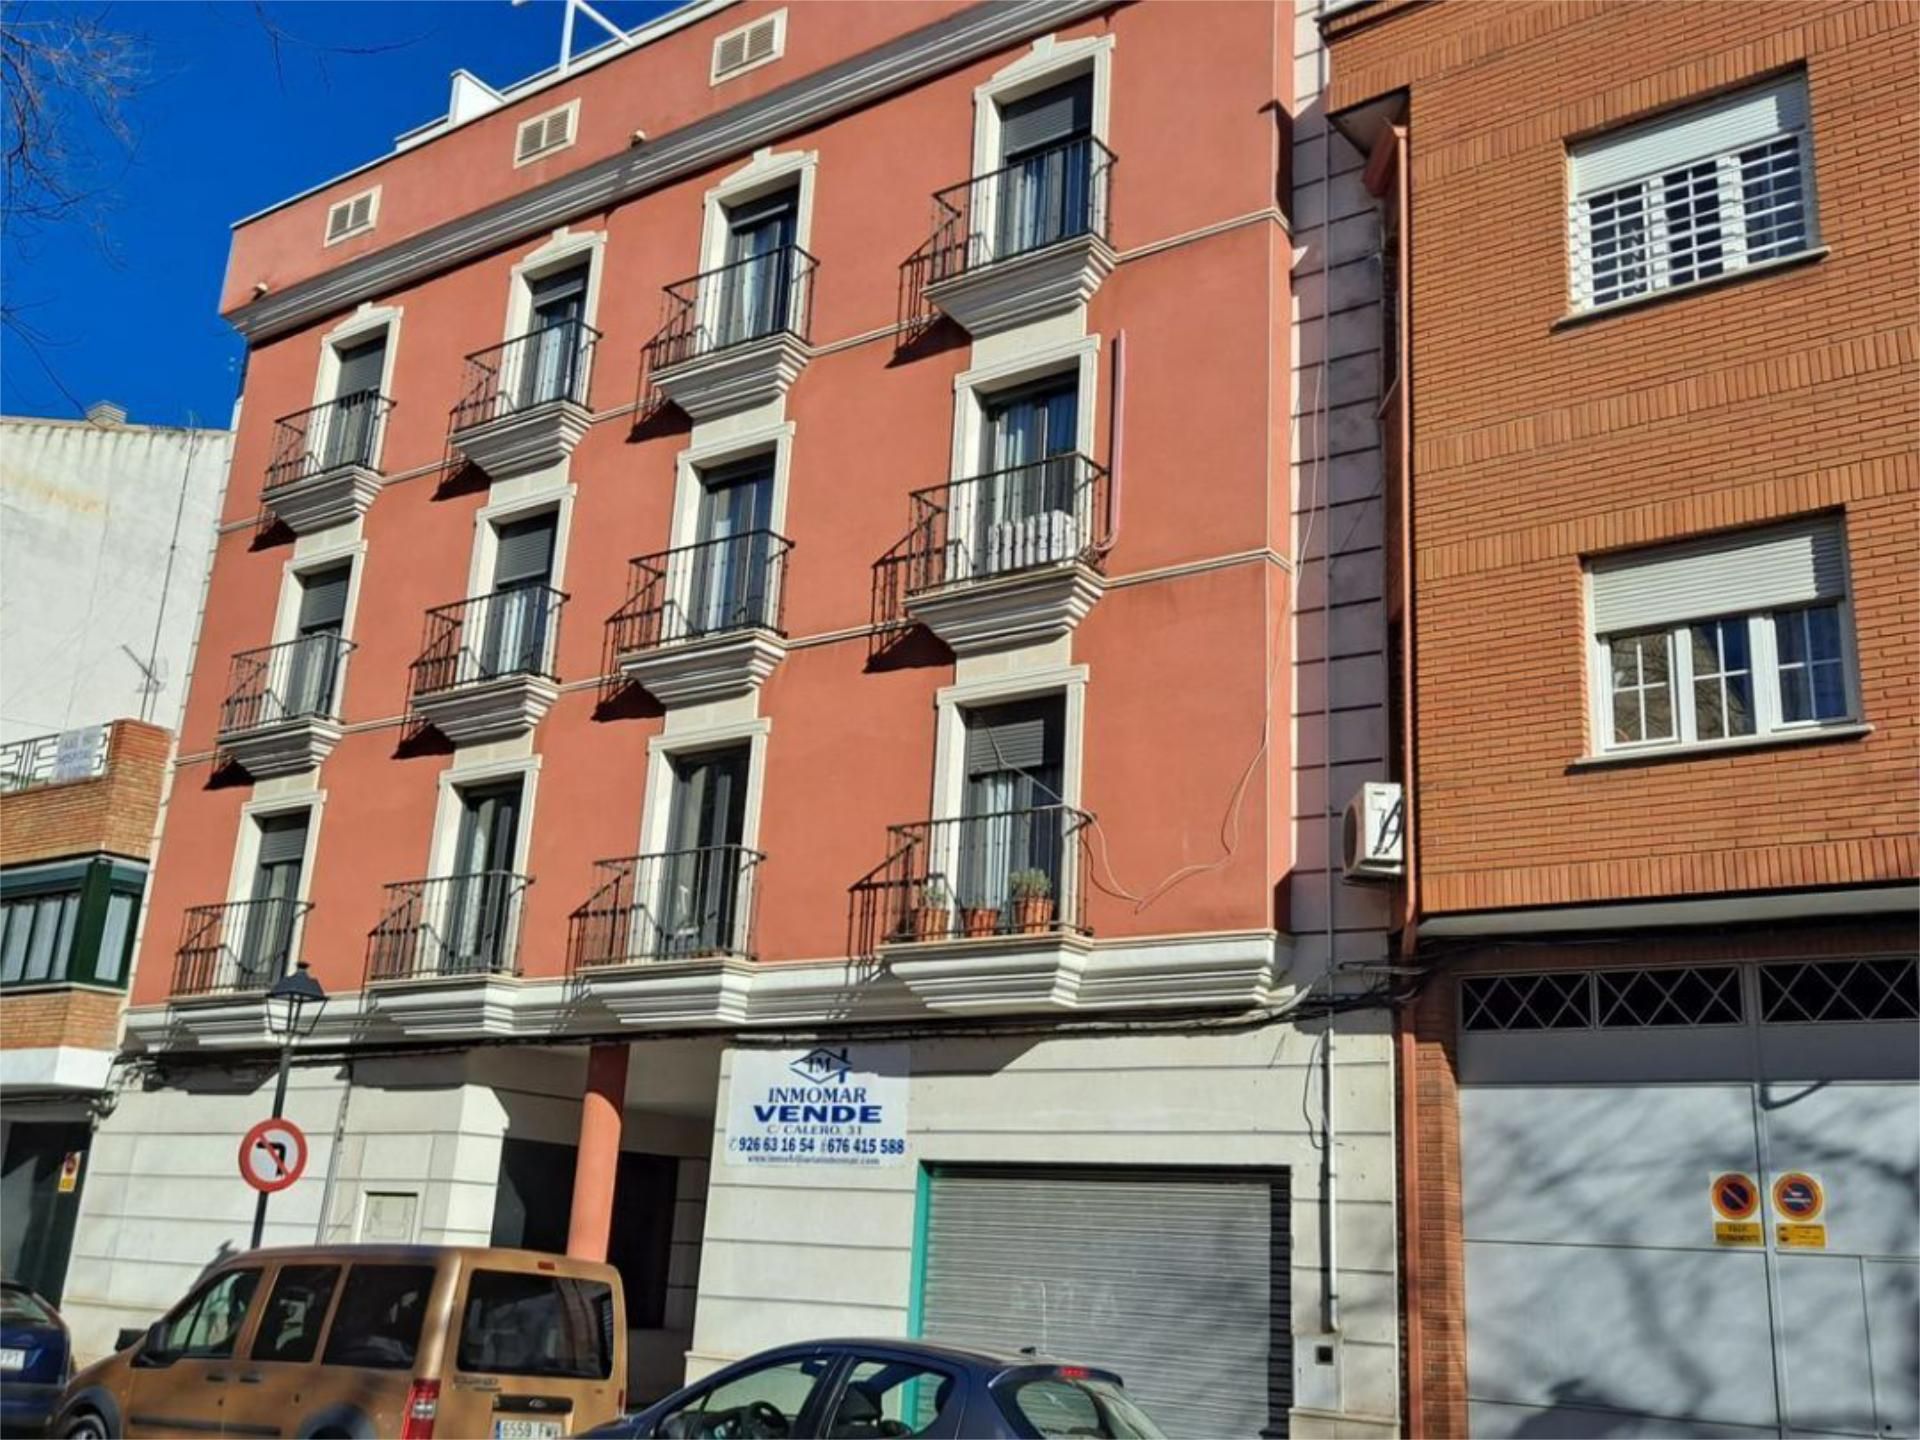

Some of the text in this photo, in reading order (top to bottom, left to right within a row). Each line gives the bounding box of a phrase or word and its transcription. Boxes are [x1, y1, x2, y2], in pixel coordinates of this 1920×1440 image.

[768, 1087, 867, 1103] INMOMAR
[753, 1104, 882, 1123] VENDE
[739, 1136, 905, 1155] 926 63 16 54 676 415 588
